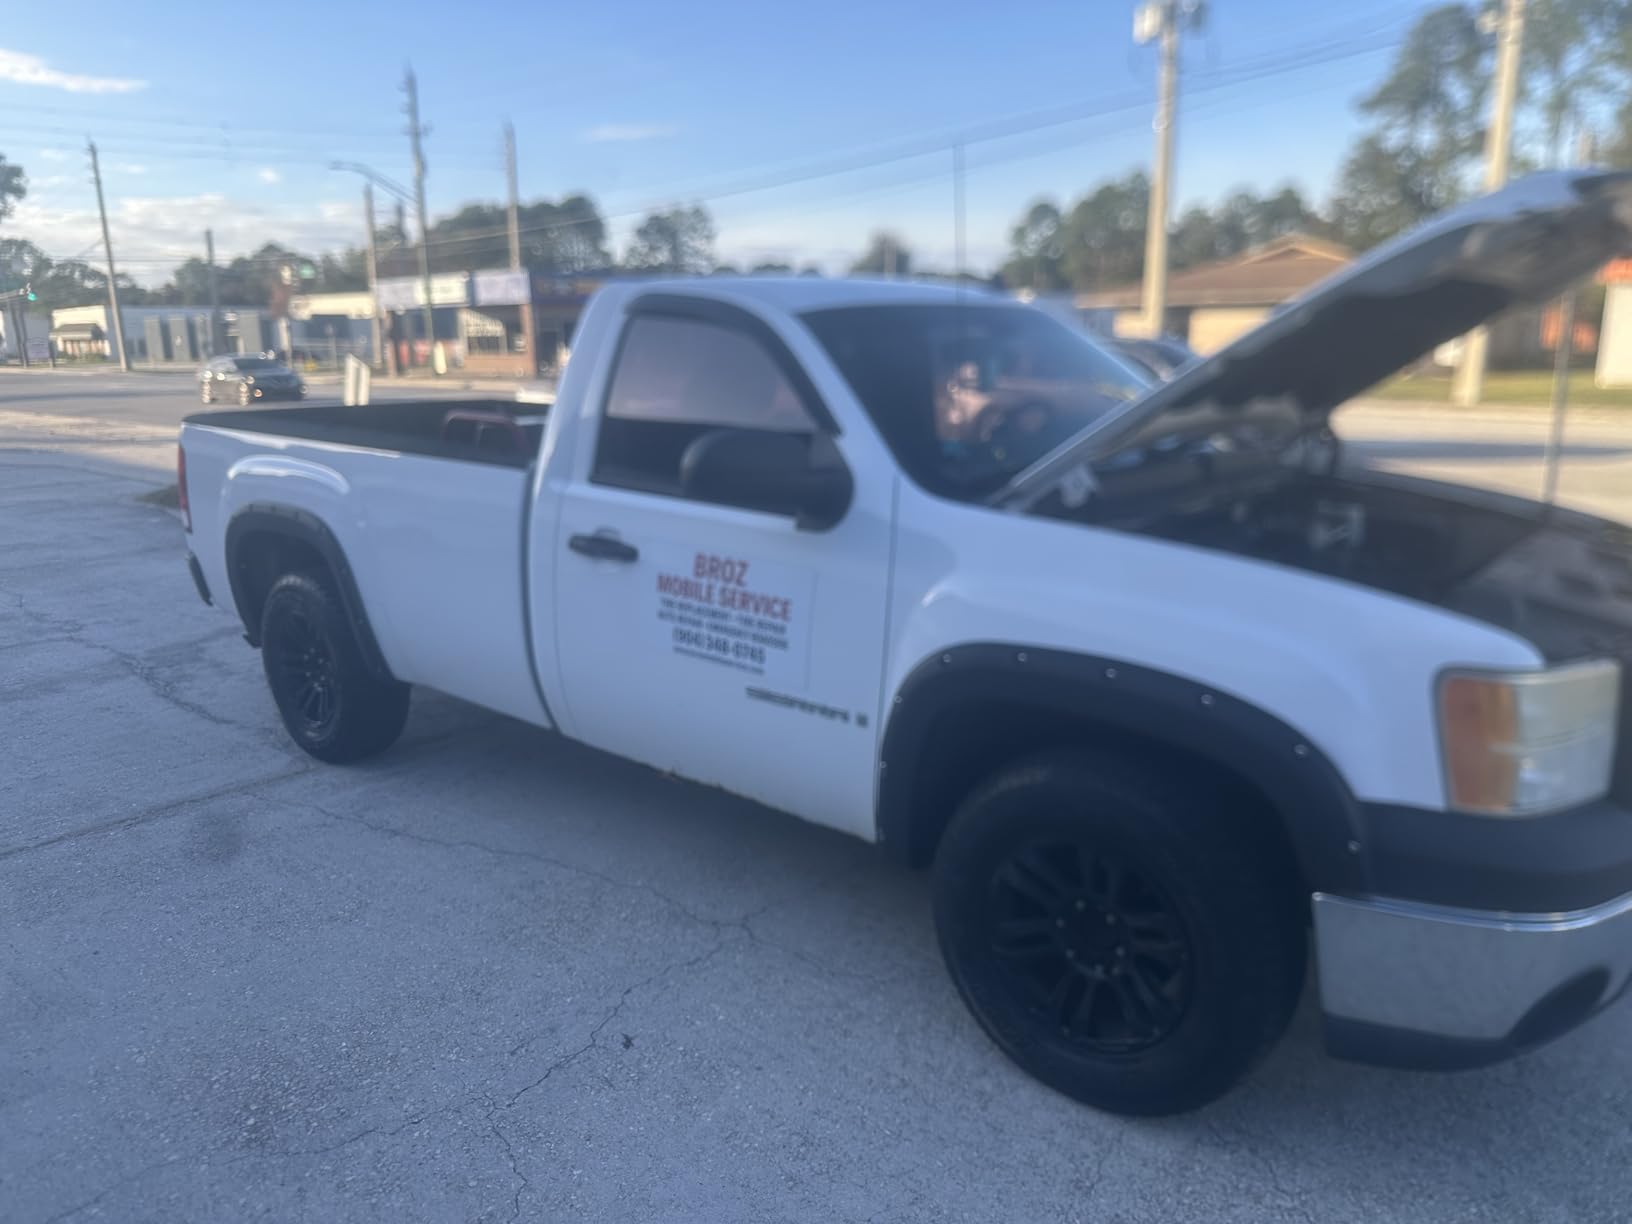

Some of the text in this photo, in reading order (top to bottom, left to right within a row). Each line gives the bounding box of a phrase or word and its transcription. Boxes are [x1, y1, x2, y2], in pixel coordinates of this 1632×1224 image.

[693, 553, 749, 587] BROZ
[657, 573, 792, 622] MOBILE SERVICE
